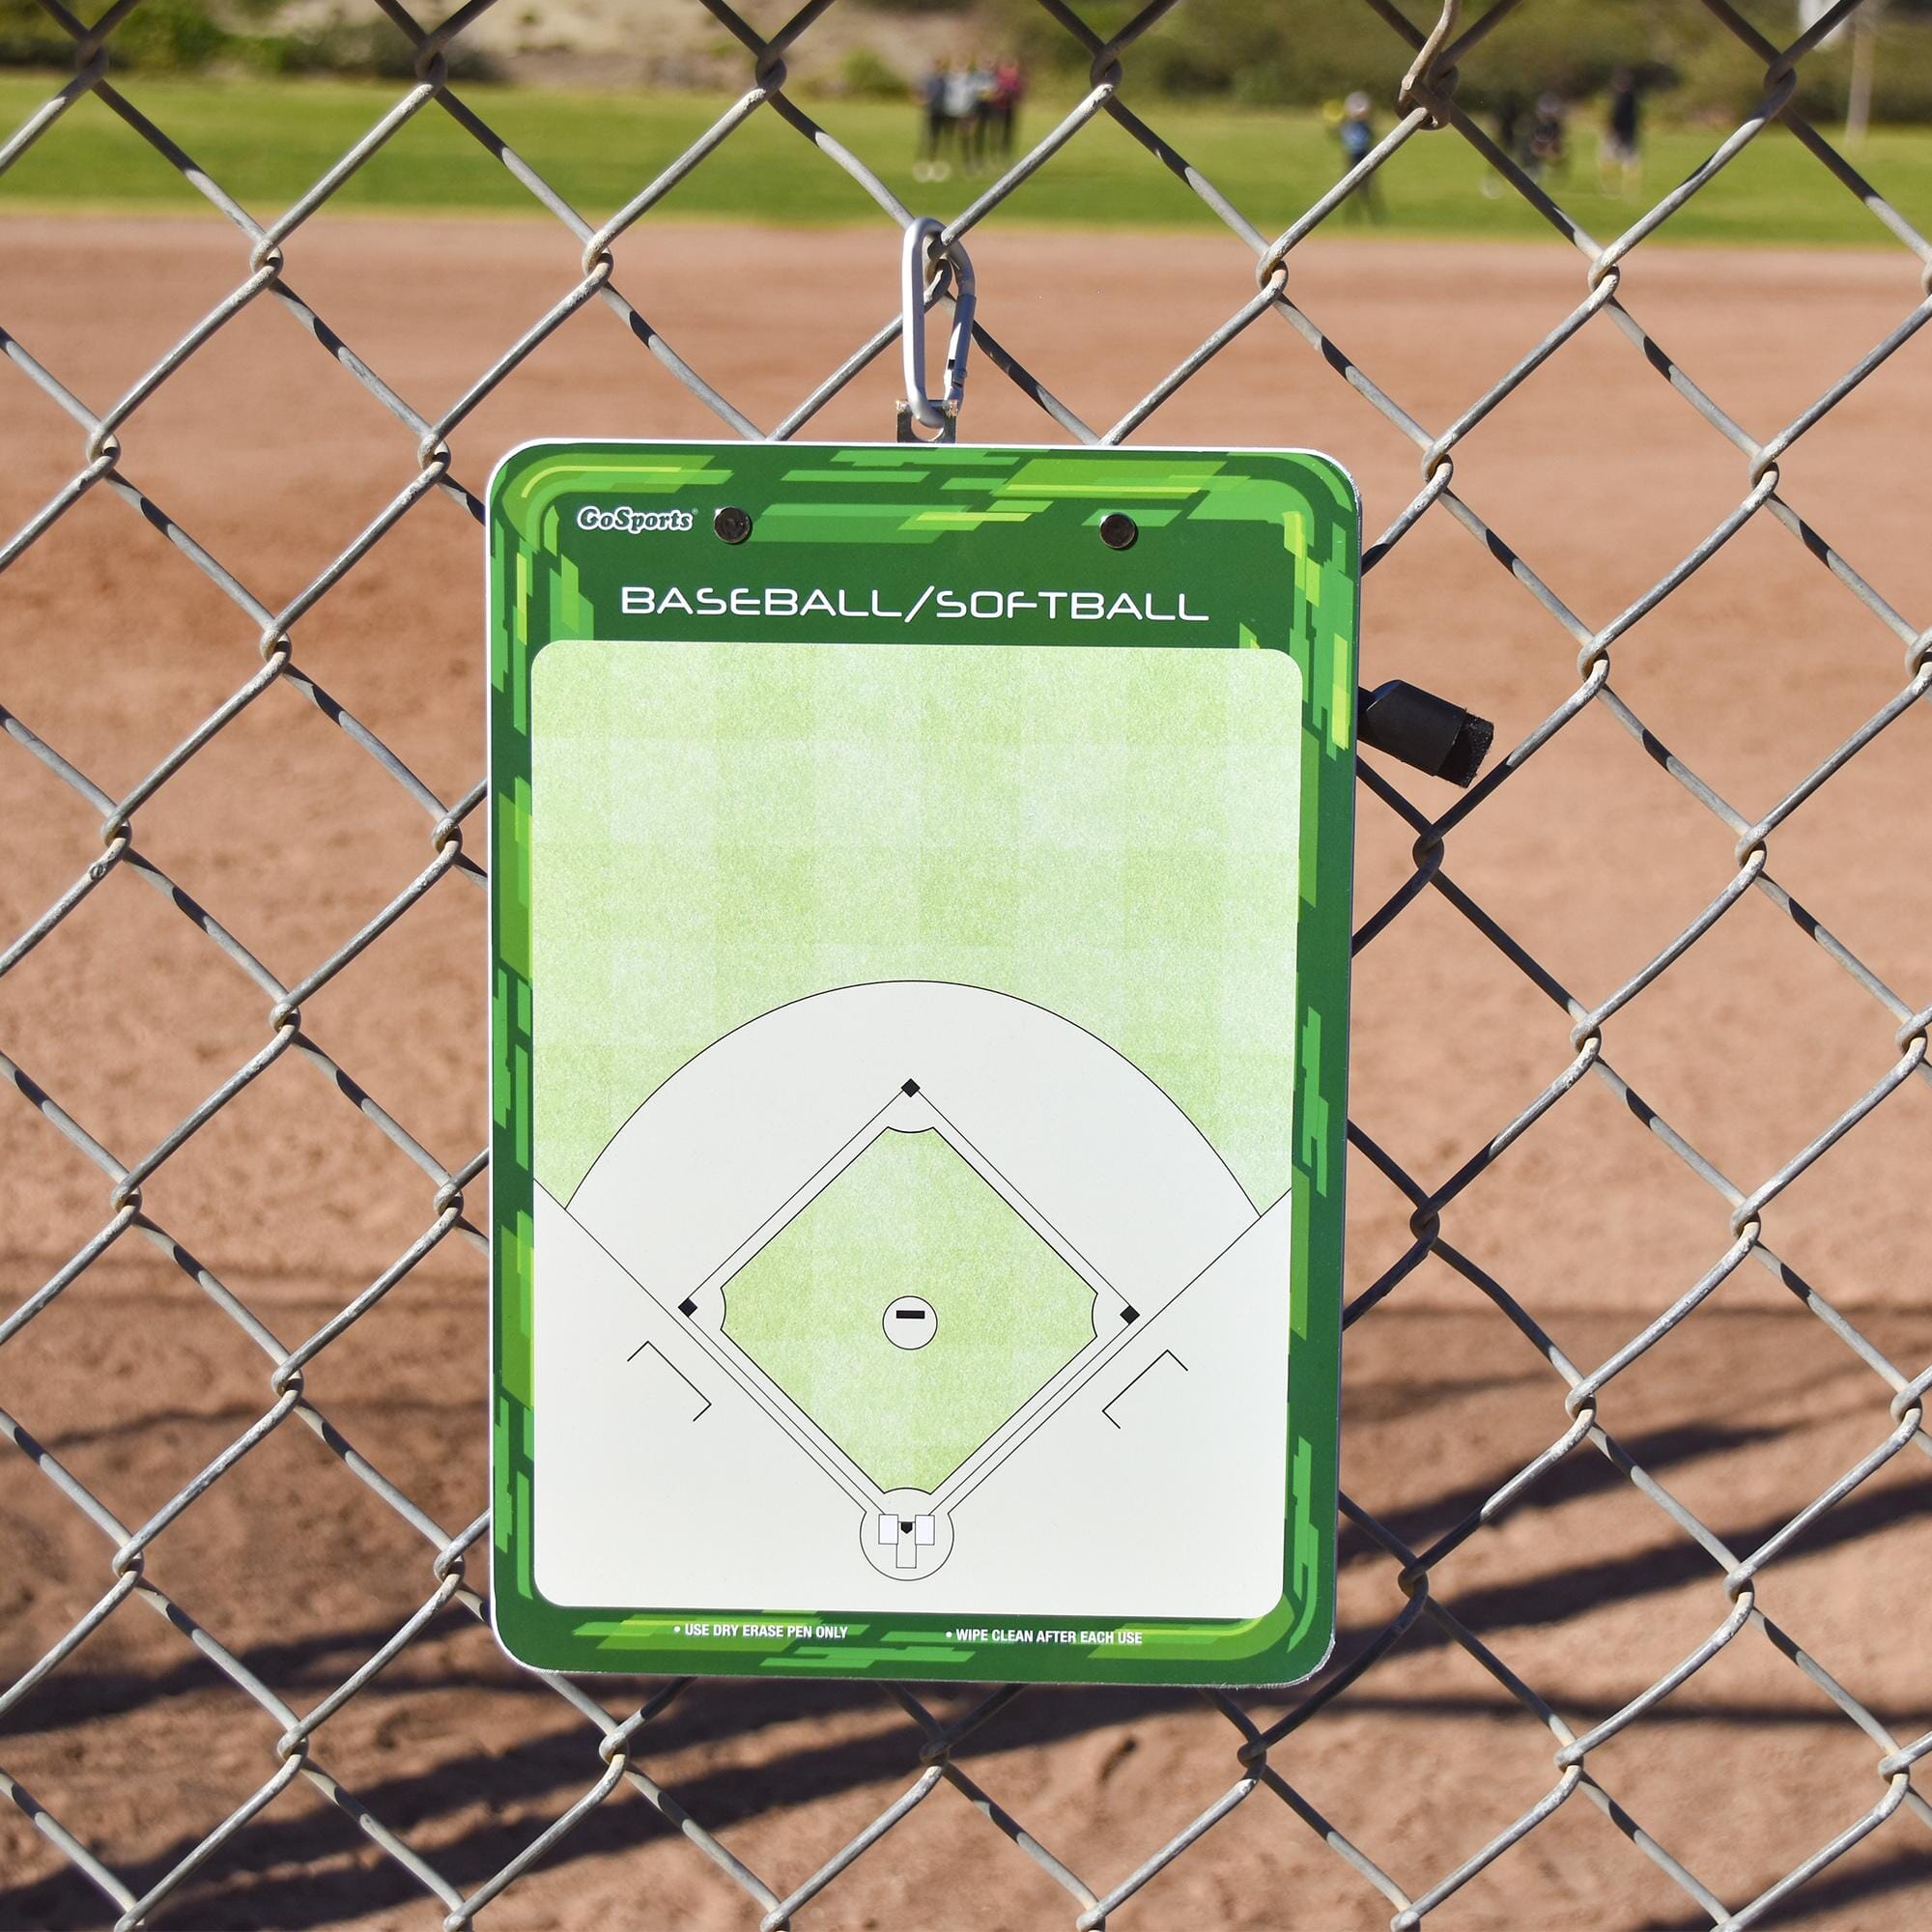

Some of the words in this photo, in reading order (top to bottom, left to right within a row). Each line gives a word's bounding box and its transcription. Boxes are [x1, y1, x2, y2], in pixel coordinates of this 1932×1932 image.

[621, 585, 1210, 622] BASEBALL/SOFTBALL
[684, 1623, 710, 1636] USE
[712, 1623, 739, 1636] DRY
[742, 1624, 784, 1637] ERASE
[786, 1625, 812, 1638] PEN
[815, 1625, 848, 1639] ONLY
[955, 1628, 988, 1641] WIPE
[991, 1629, 1034, 1642] CLEAN
[1036, 1630, 1077, 1643] AFTER
[1080, 1631, 1115, 1644] EACH
[1117, 1631, 1143, 1645] USE
